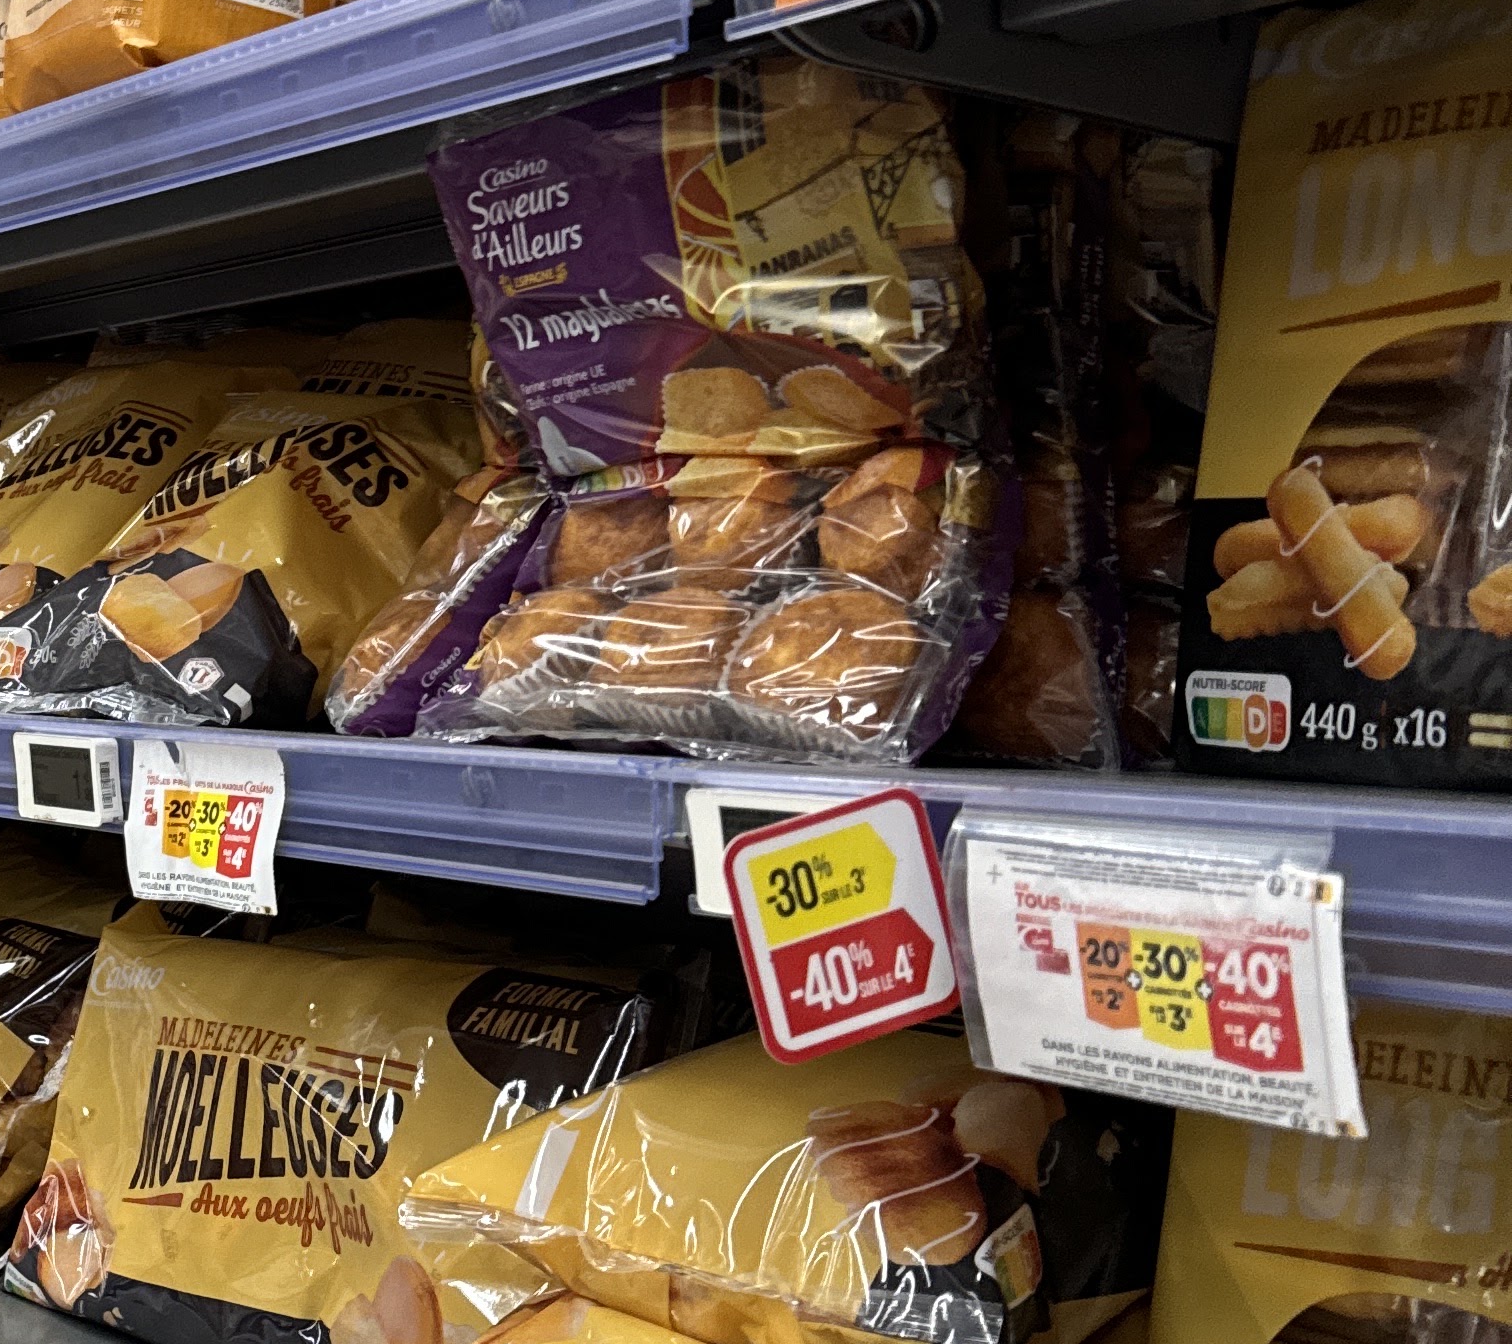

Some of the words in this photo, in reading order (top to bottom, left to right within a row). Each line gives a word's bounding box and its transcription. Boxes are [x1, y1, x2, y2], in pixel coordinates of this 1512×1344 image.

[479, 158, 548, 192] Casino
[467, 181, 570, 231] Saveurs
[471, 221, 584, 273] d'Ailleurs
[500, 313, 540, 351] 12
[540, 287, 683, 344] magdalenas
[551, 370, 588, 389] origine
[590, 364, 606, 379] UE
[552, 387, 591, 405] origine
[591, 376, 636, 397] Espagne
[75, 457, 141, 496] frais
[1191, 677, 1266, 693] NUTRI-SCORE
[1247, 705, 1267, 735] D
[1299, 702, 1357, 741] 440
[1361, 720, 1379, 751] g
[1392, 708, 1448, 748] x16
[244, 780, 274, 795] Casino
[164, 799, 197, 820] -20%
[196, 800, 226, 825] -30%
[225, 800, 263, 832] -40%
[766, 852, 834, 918] -30%
[1014, 891, 1063, 912] TOUS
[1079, 938, 1129, 969] -20%
[1133, 942, 1200, 982] -30%
[90, 955, 166, 997] Casino
[790, 939, 875, 1012] -40%
[858, 979, 881, 998] SUR
[880, 972, 896, 992] LE
[1203, 948, 1291, 1001] -40%
[491, 981, 596, 1013] FORMAT
[157, 1016, 307, 1066] MADELEINES
[462, 1007, 581, 1055] FAMILIAL
[1040, 1037, 1074, 1056] DANS
[1101, 1044, 1153, 1069] RAYONS
[1055, 1055, 1108, 1077] HYGIÈNE
[1113, 1064, 1128, 1079] ET
[1132, 1069, 1203, 1093] ENTRETIEN
[1205, 1080, 1225, 1097] DE
[1226, 1084, 1246, 1101] LA
[128, 1047, 405, 1191] MOELLEUSES
[190, 1189, 250, 1220] Aux
[254, 1181, 326, 1248] oeufs
[323, 1183, 374, 1255] frais
